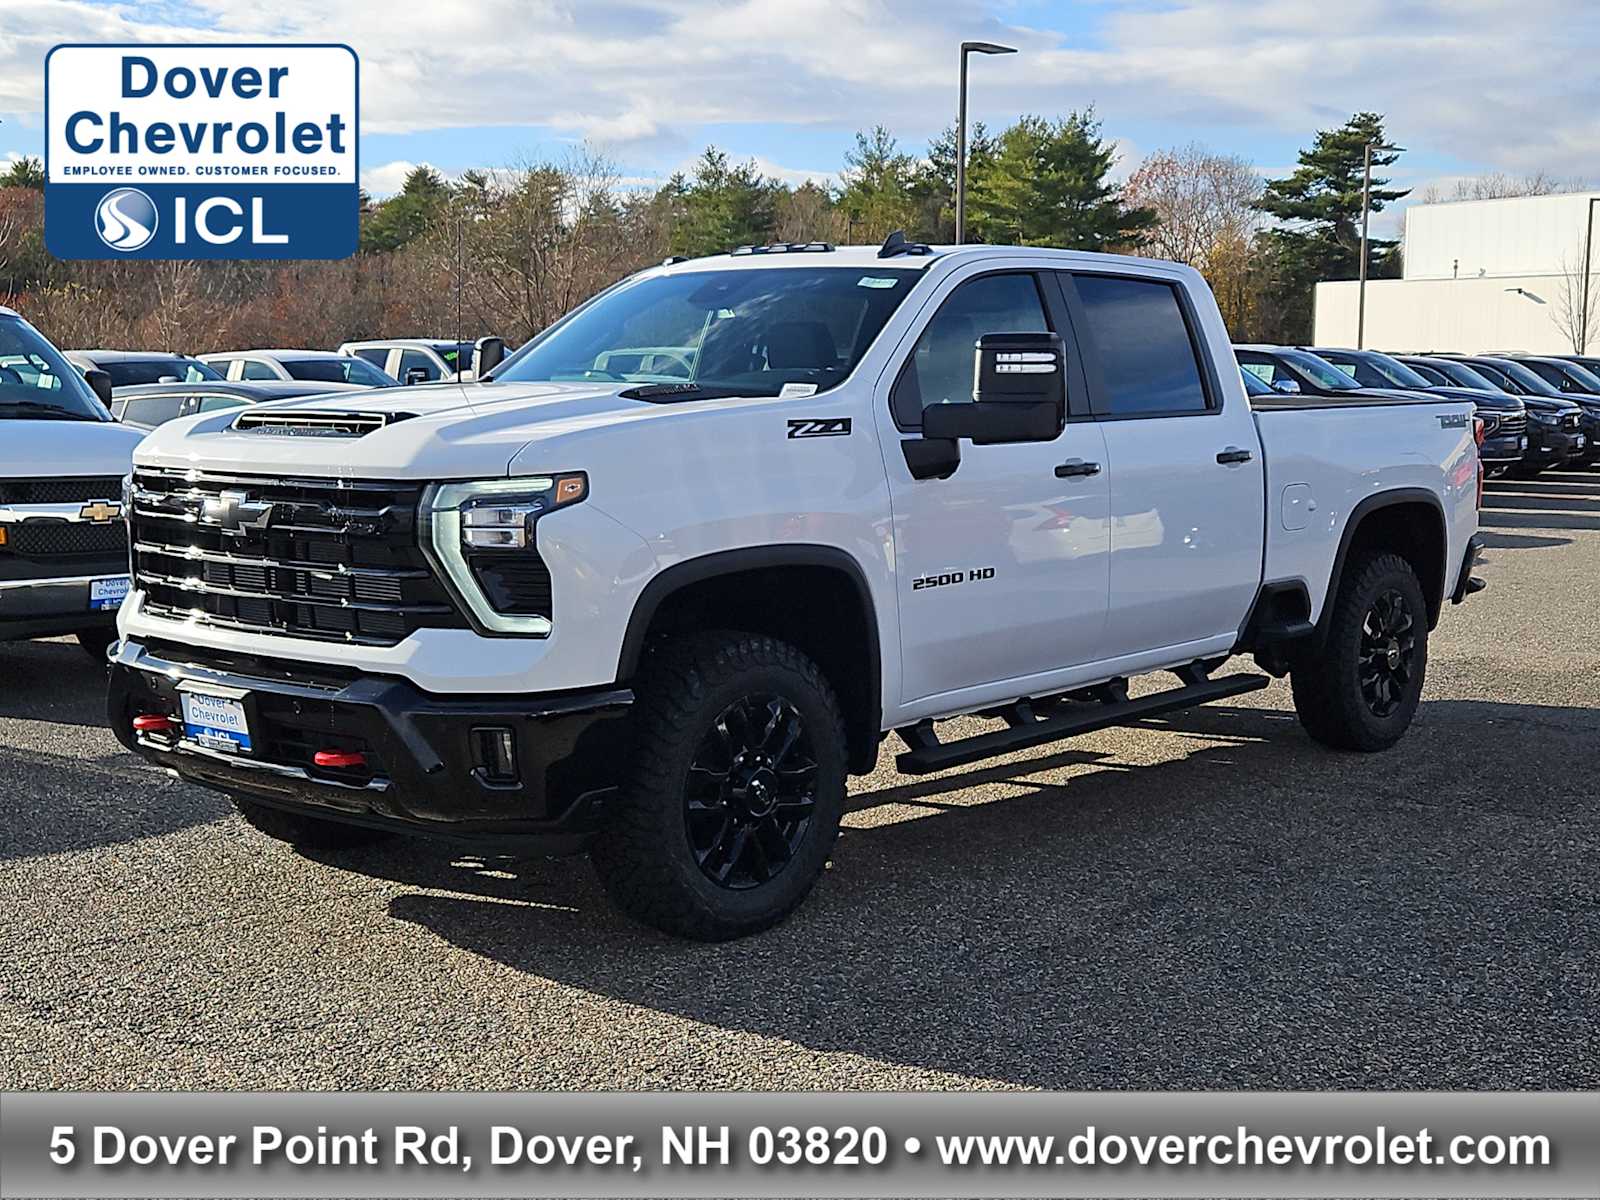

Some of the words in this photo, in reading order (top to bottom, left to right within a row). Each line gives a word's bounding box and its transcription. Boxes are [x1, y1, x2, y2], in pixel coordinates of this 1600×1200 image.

[912, 572, 964, 591] 2500
[969, 567, 995, 581] HD
[191, 706, 239, 726] Chevrolet
